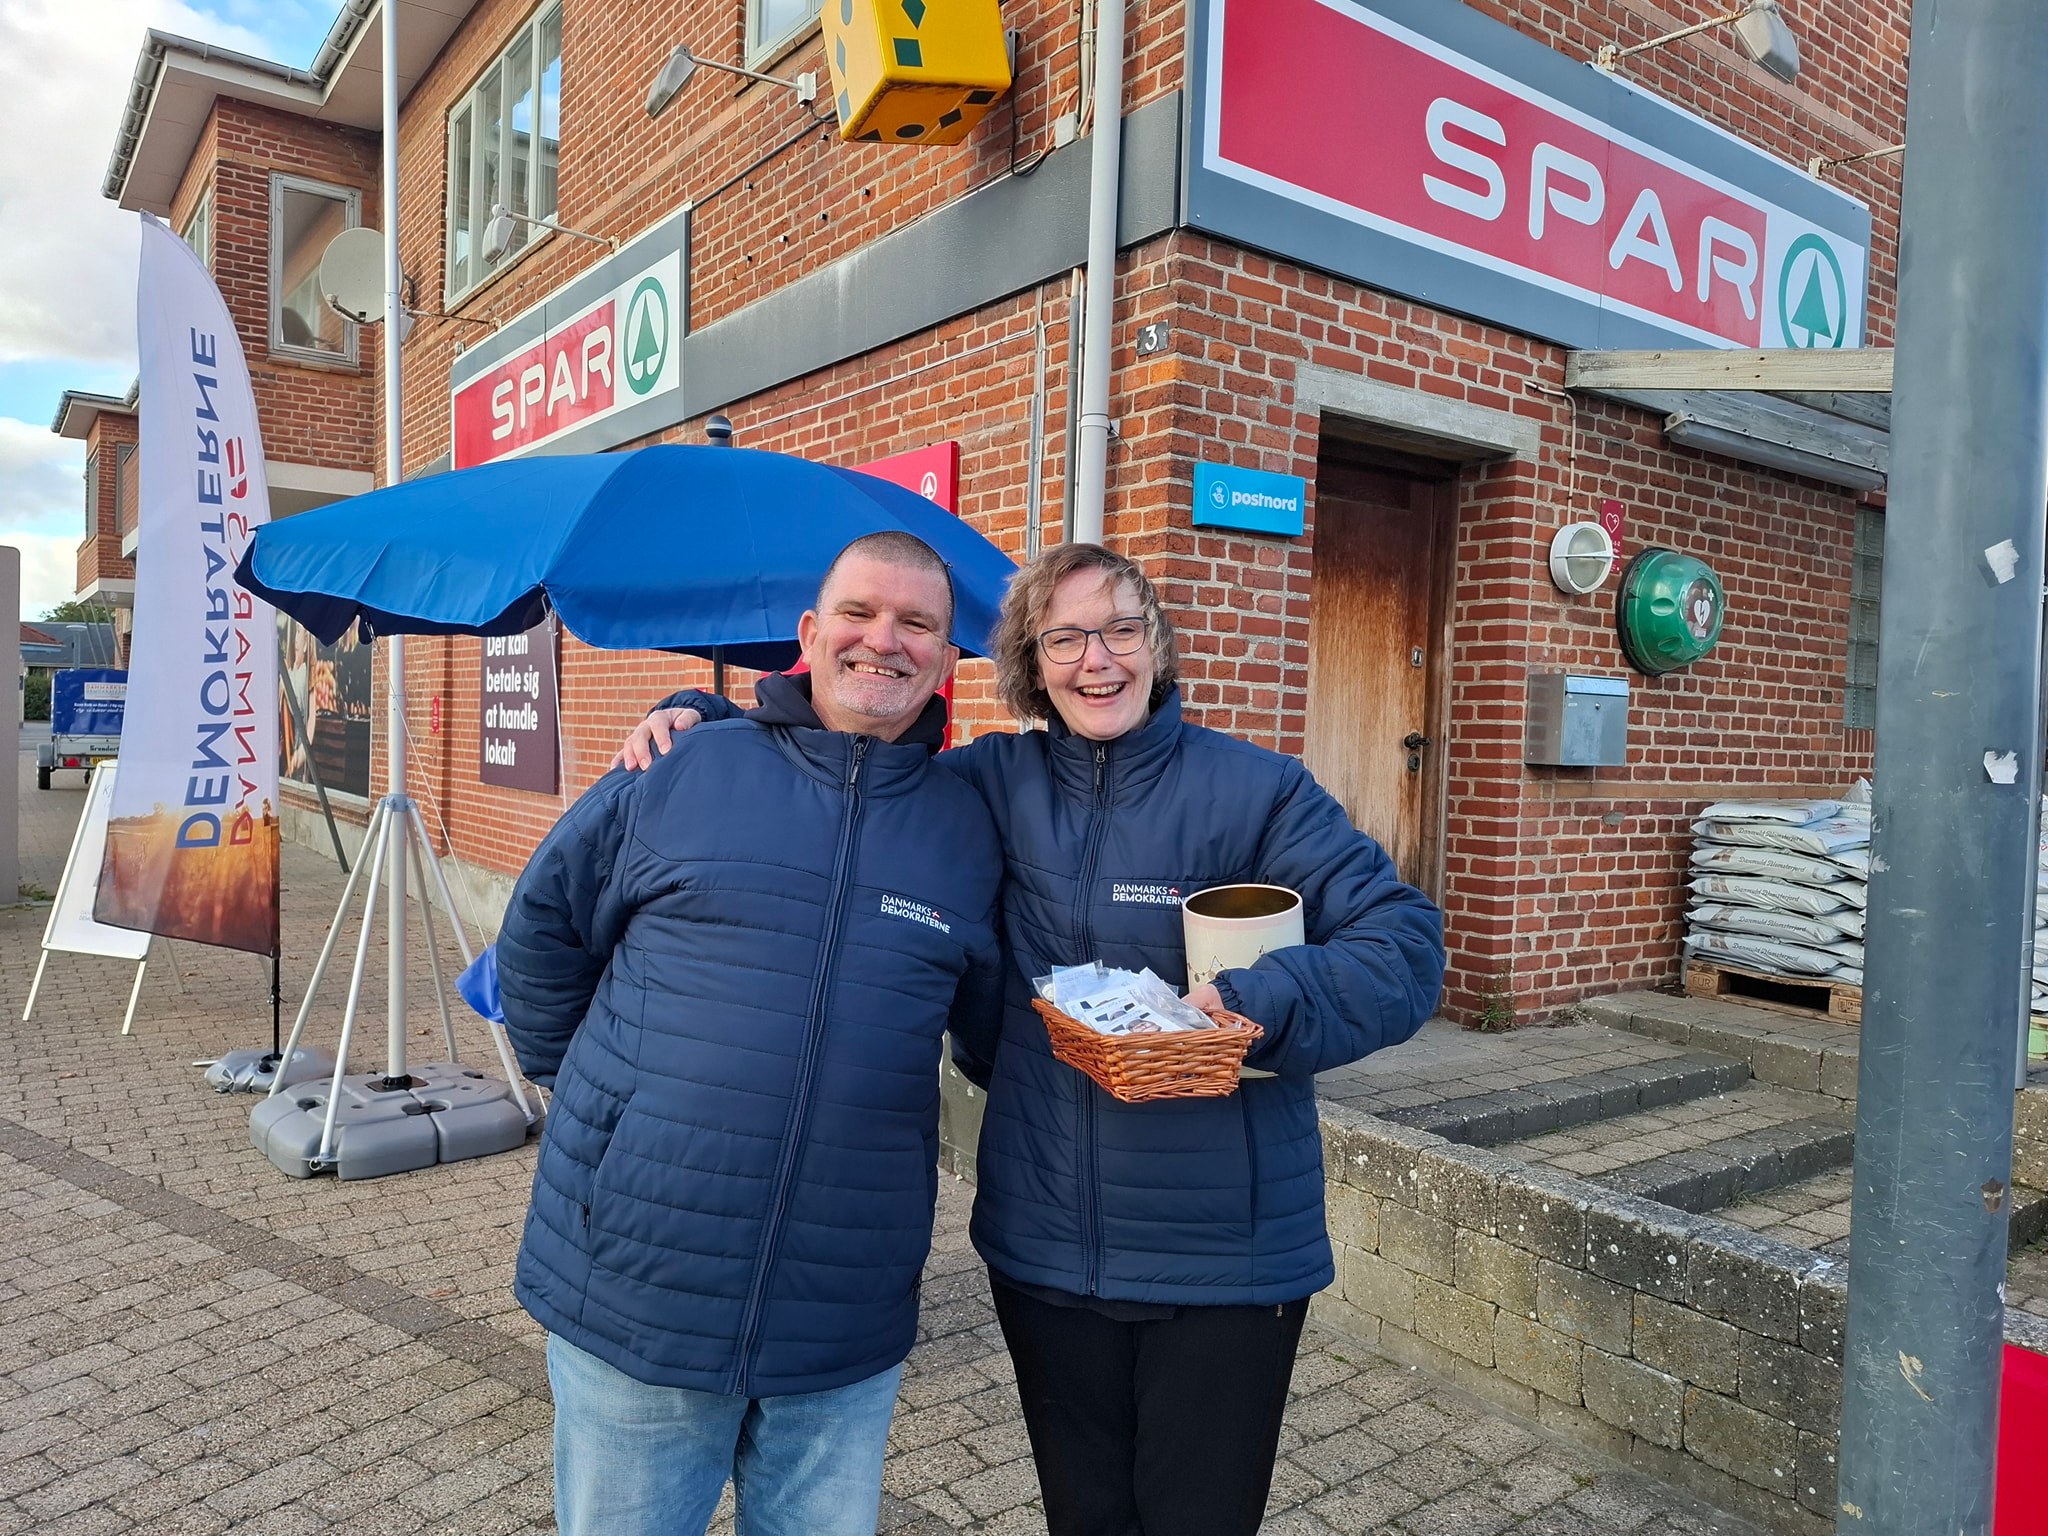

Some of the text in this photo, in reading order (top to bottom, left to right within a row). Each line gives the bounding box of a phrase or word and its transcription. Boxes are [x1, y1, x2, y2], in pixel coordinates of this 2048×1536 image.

[1422, 97, 1759, 321] SPAR
[1145, 325, 1158, 351] 3
[492, 325, 612, 441] SPAR
[1231, 490, 1297, 512] postnord
[487, 634, 528, 657] Det kan
[486, 665, 540, 700] betale sig
[485, 702, 538, 731] at handle
[485, 737, 516, 766] lokalt
[1113, 884, 1168, 895] DANMARKS
[881, 903, 951, 934] DEMOKRATERNE
[882, 894, 932, 917] DANMARKS
